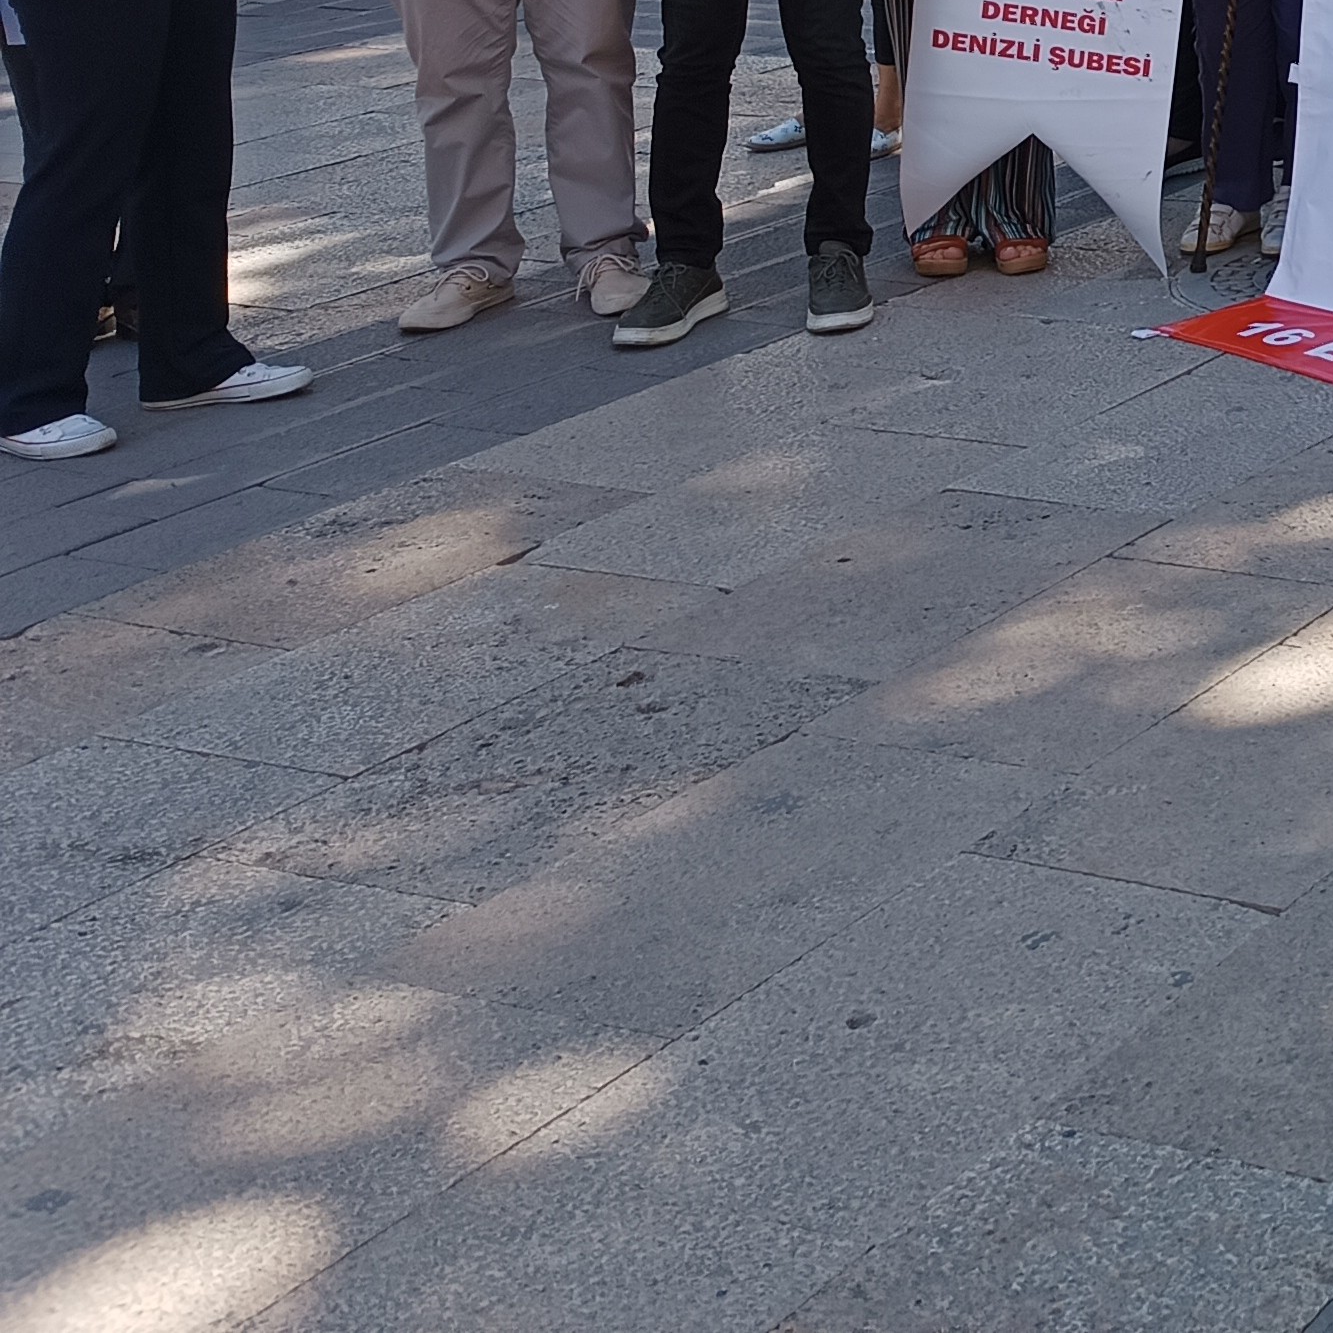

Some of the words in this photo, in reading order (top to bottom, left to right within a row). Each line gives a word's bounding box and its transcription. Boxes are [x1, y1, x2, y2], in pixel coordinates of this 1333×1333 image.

[981, 0, 1107, 36] DERNEĞİ
[931, 29, 1041, 63] DENİZLİ
[1048, 53, 1152, 78] ŞUBESİ
[1236, 320, 1297, 347] 16
